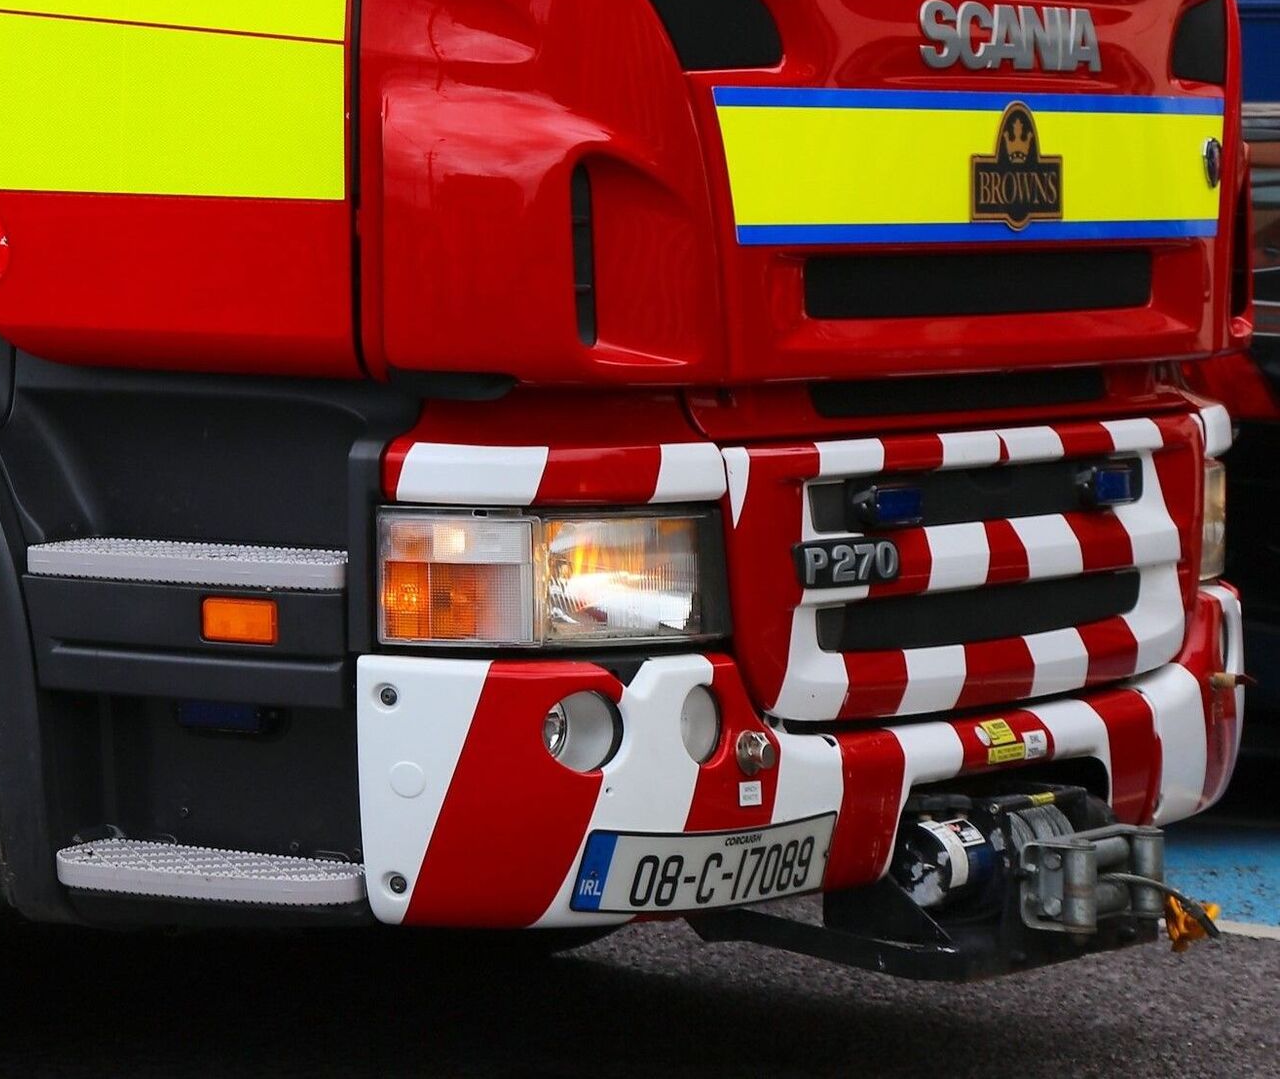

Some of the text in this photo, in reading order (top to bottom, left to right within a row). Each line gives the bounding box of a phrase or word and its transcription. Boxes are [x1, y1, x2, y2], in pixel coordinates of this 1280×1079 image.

[979, 171, 1058, 205] BROWNS
[725, 833, 762, 847] CORCAIGH
[579, 835, 815, 908] IRL 08-C-17089
